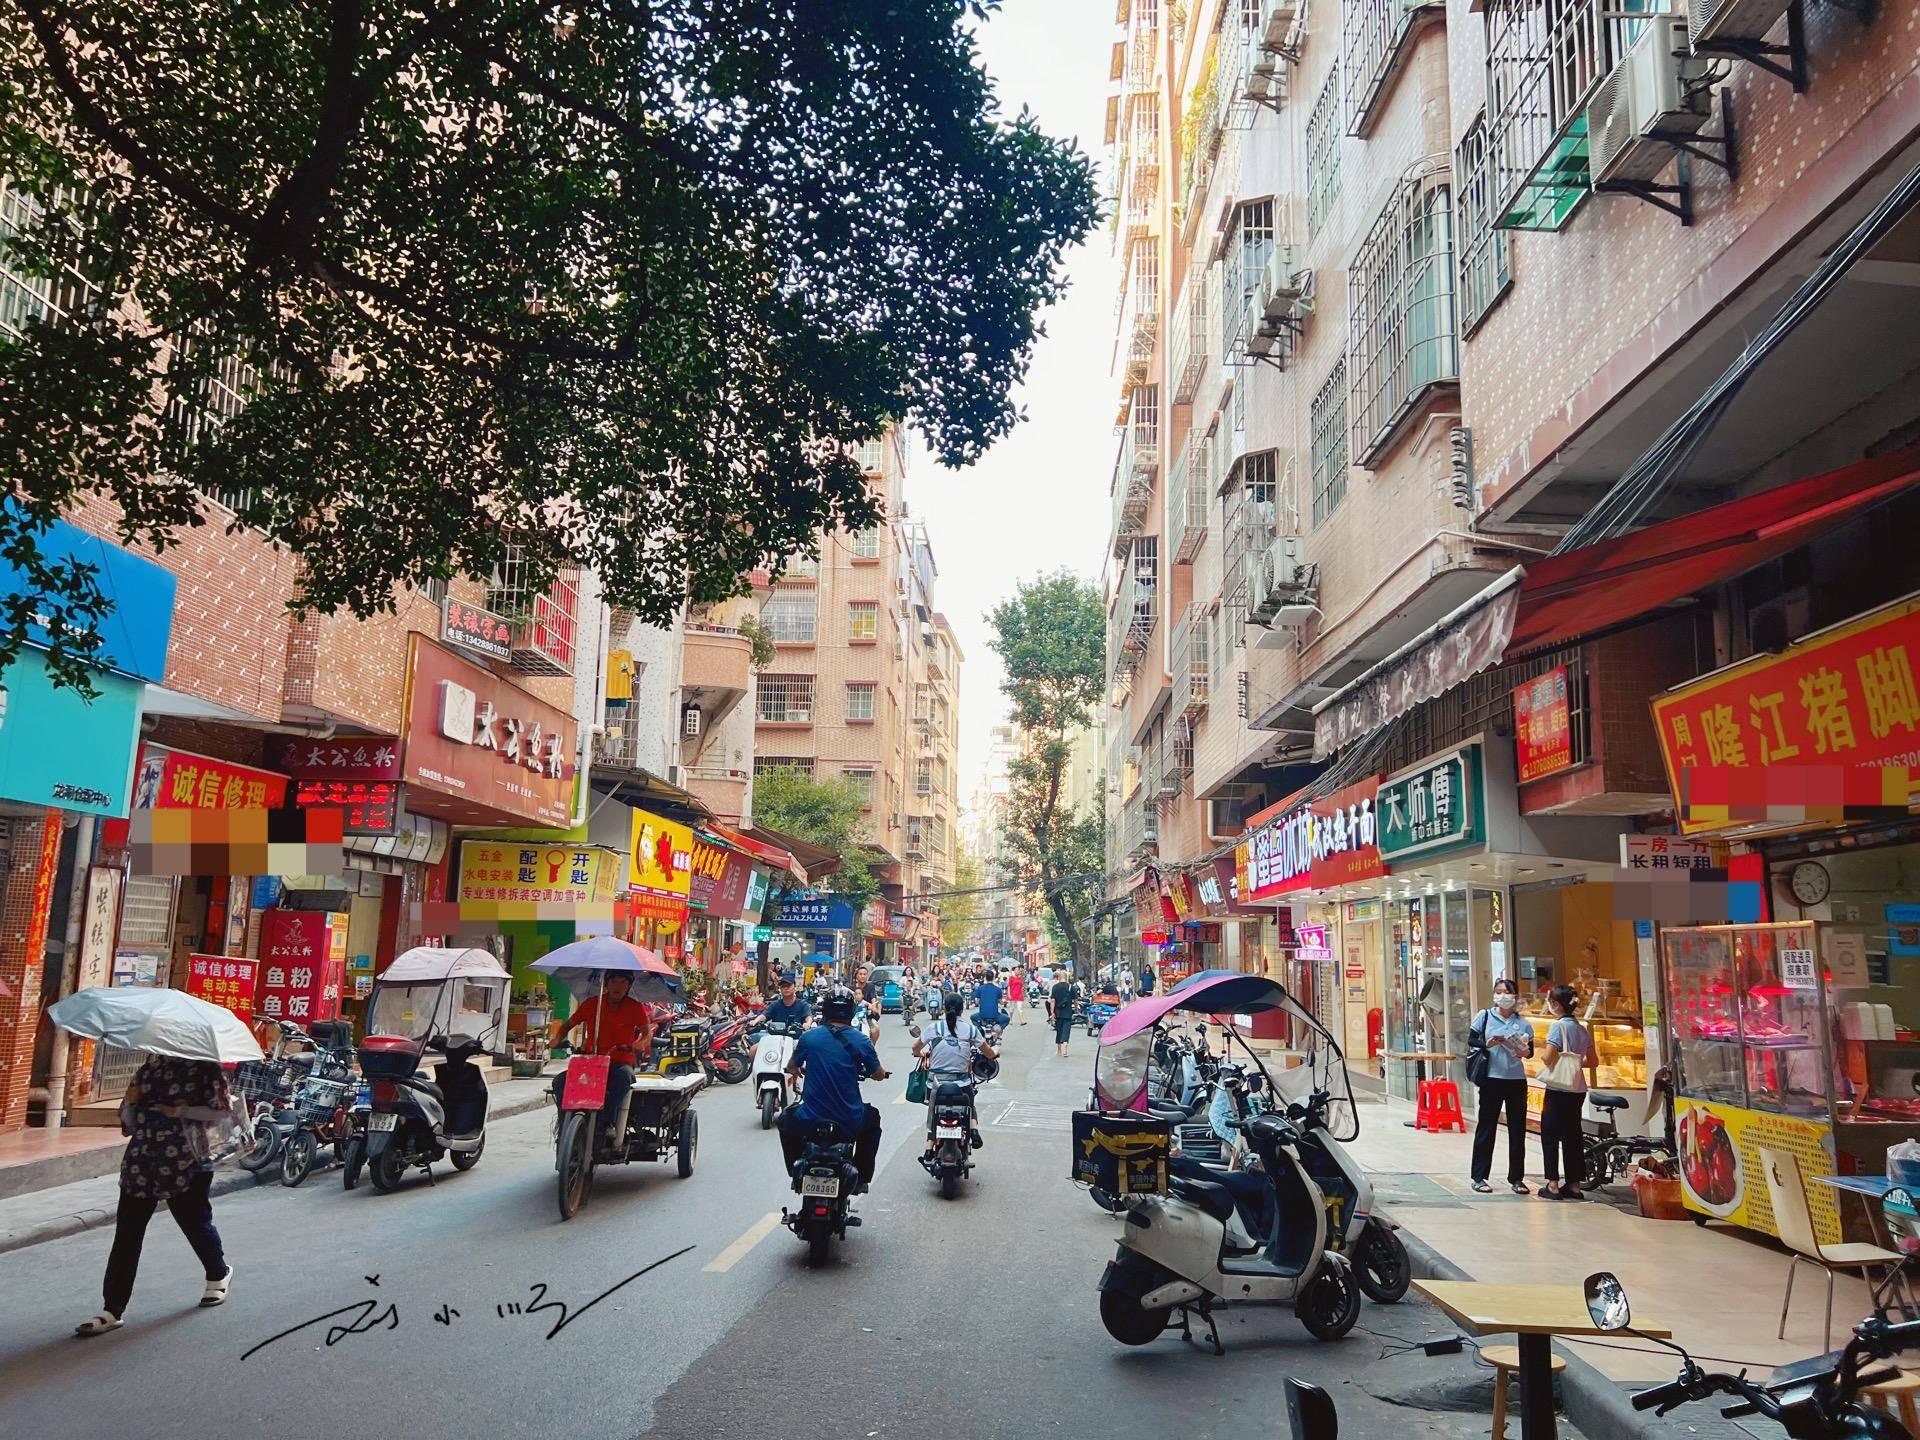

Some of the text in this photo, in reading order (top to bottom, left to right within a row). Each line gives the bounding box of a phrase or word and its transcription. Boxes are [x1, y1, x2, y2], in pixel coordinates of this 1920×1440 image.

[1700, 645, 1919, 767] 隆江猪脚
[172, 764, 267, 808] 诚信修理
[1385, 765, 1450, 834] 大师傅
[1629, 836, 1710, 853] 一房一厅
[479, 850, 503, 863] 五金
[1630, 854, 1711, 868] 长租短租
[464, 869, 514, 882] 水电安装
[462, 886, 586, 902] 专业维修拆装空调加雪种
[194, 960, 253, 980] 诚信修理
[265, 966, 313, 989] 鱼粉
[203, 977, 240, 994] 电动车
[263, 994, 310, 1018] 鱼饭
